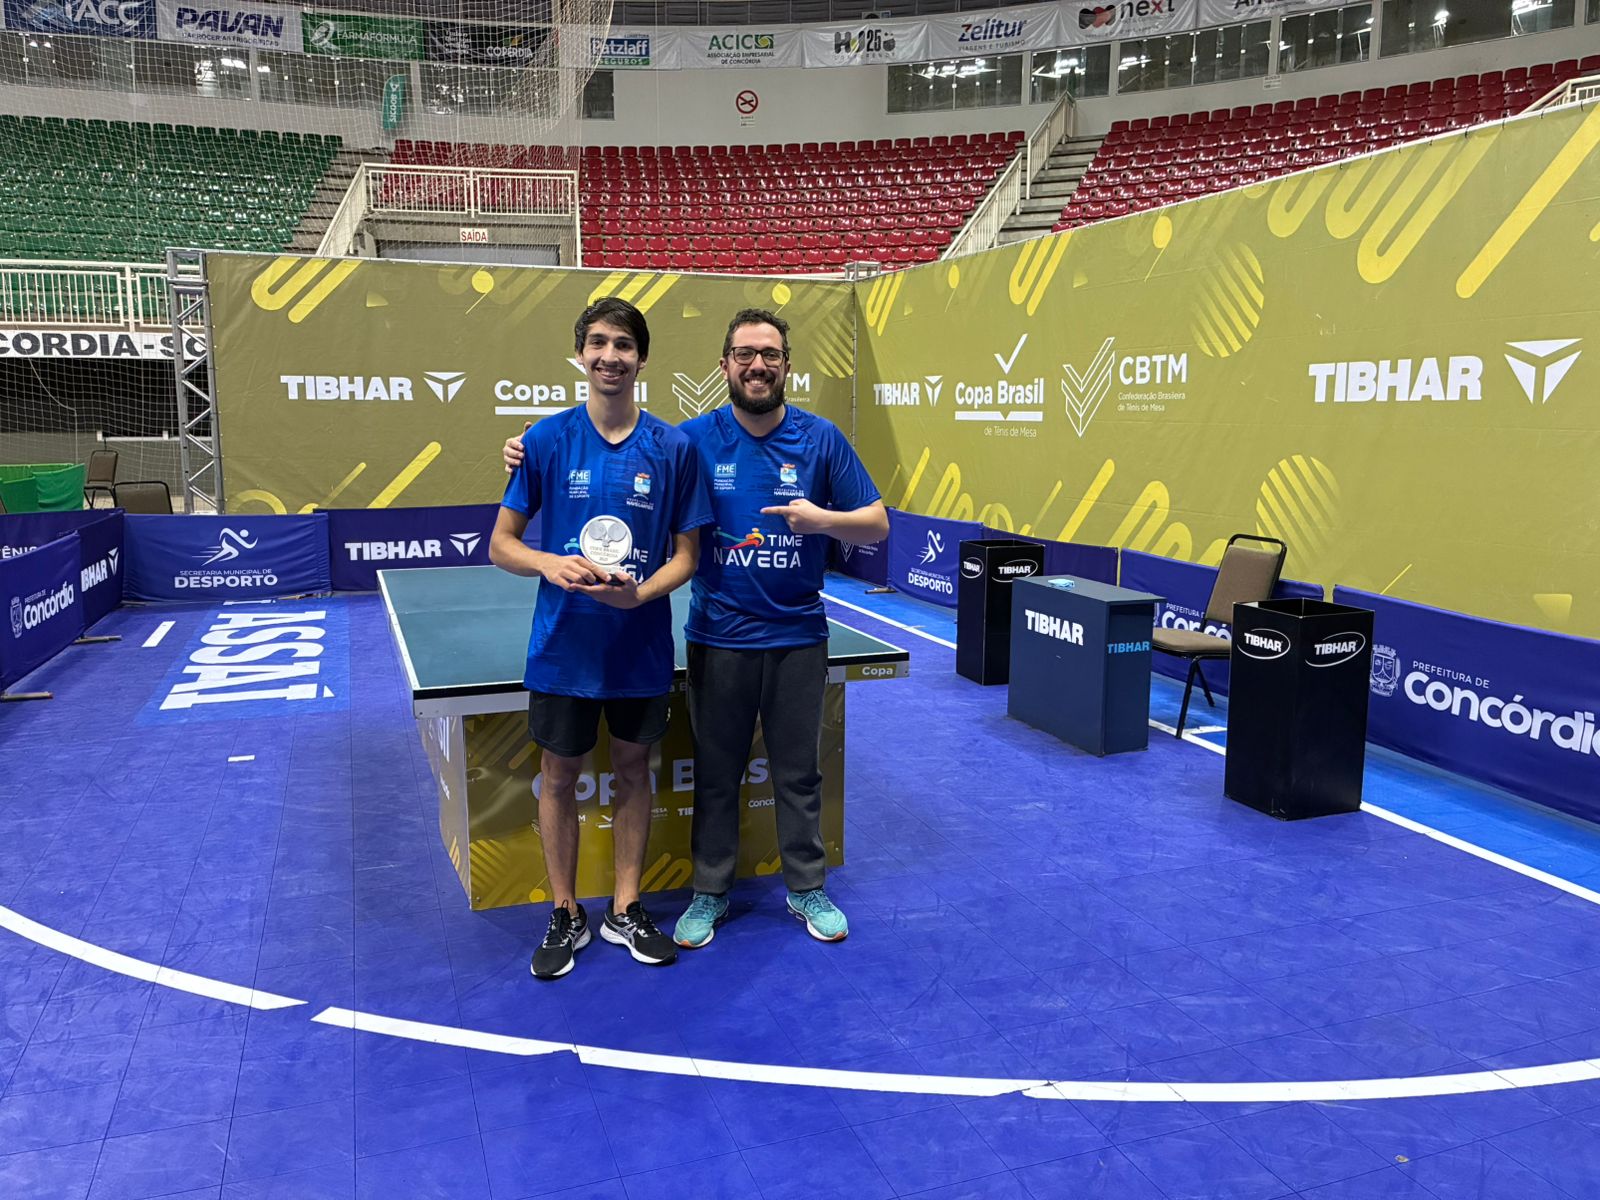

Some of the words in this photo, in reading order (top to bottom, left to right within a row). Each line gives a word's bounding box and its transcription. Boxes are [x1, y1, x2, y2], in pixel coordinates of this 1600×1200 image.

[176, 7, 284, 38] PAVAN
[958, 19, 1024, 42] Zelitur
[461, 229, 488, 242] SAÍDA
[1119, 353, 1188, 385] CBTM
[1309, 355, 1483, 402] TIBHAR
[280, 375, 413, 400] TIBHAR
[494, 380, 566, 405] Copa
[873, 383, 920, 405] TIBHAR
[955, 382, 992, 409] Copa
[998, 377, 1044, 404] Brasil
[1118, 392, 1157, 401] Confederação
[1158, 391, 1185, 400] Brasileira
[1150, 403, 1165, 411] Mesa
[984, 426, 992, 436] de
[994, 425, 1008, 436] Tênis
[1010, 426, 1018, 437] de
[1020, 427, 1036, 438] Mesa
[570, 471, 589, 480] FME
[717, 464, 735, 473] FME
[344, 539, 442, 561] TIBHAR
[767, 534, 803, 547] TIME
[713, 546, 802, 568] NAVEGA
[963, 560, 981, 573] TIBHAR
[81, 558, 108, 592] IBHAR
[998, 565, 1031, 574] TIBHAR
[174, 574, 278, 588] DESPORTO
[908, 572, 953, 595] DESPORTO
[1166, 602, 1200, 617] PREFEITURA
[1025, 609, 1084, 646] TIBHAR
[1107, 641, 1150, 654] TIBHAR
[1244, 632, 1282, 653] TIBHAR
[1314, 641, 1357, 656] TIBHAR
[159, 610, 335, 710] ASSAÍ
[862, 666, 893, 677] Copa
[1413, 660, 1472, 684] PREFEITURA
[1475, 677, 1490, 689] DE
[1404, 671, 1600, 758] Concórdi
